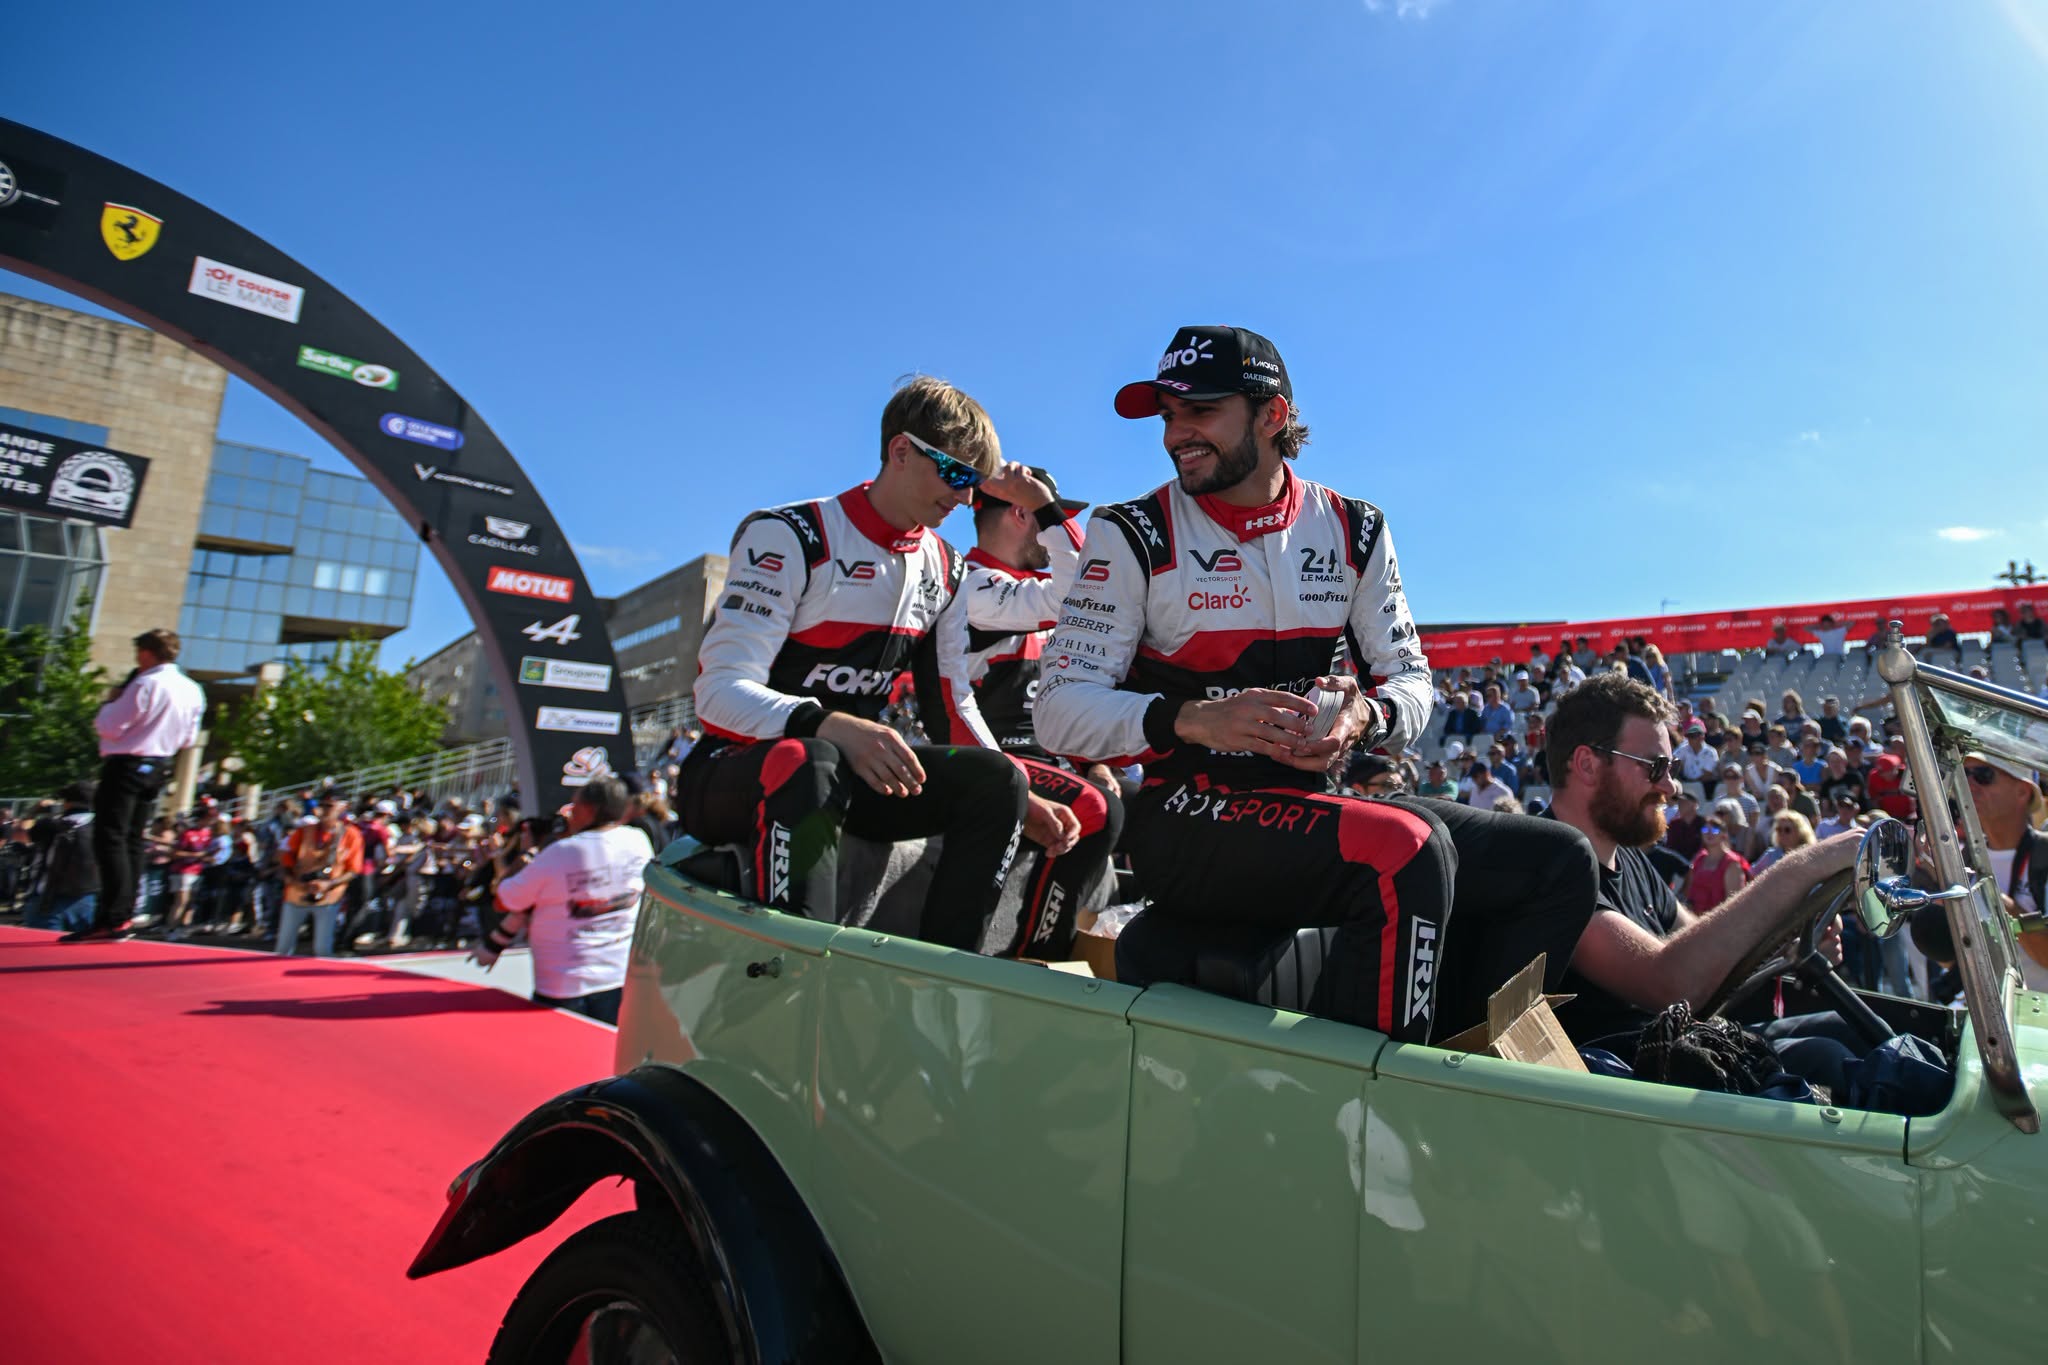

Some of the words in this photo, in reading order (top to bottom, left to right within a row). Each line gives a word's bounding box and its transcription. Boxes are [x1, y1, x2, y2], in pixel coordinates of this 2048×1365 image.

[237, 279, 292, 301] course
[1123, 504, 1164, 547] HRX
[1245, 512, 1286, 530] HRX
[491, 571, 570, 600] MOTUL
[1301, 574, 1313, 582] LE
[1315, 575, 1344, 583] MANS
[744, 602, 773, 617] ILIM
[1063, 597, 1115, 613] GOODYEAR
[1188, 586, 1250, 610] Claro
[772, 826, 791, 903] HRX
[1036, 883, 1065, 944] HRX
[1408, 921, 1436, 1022] HRX
